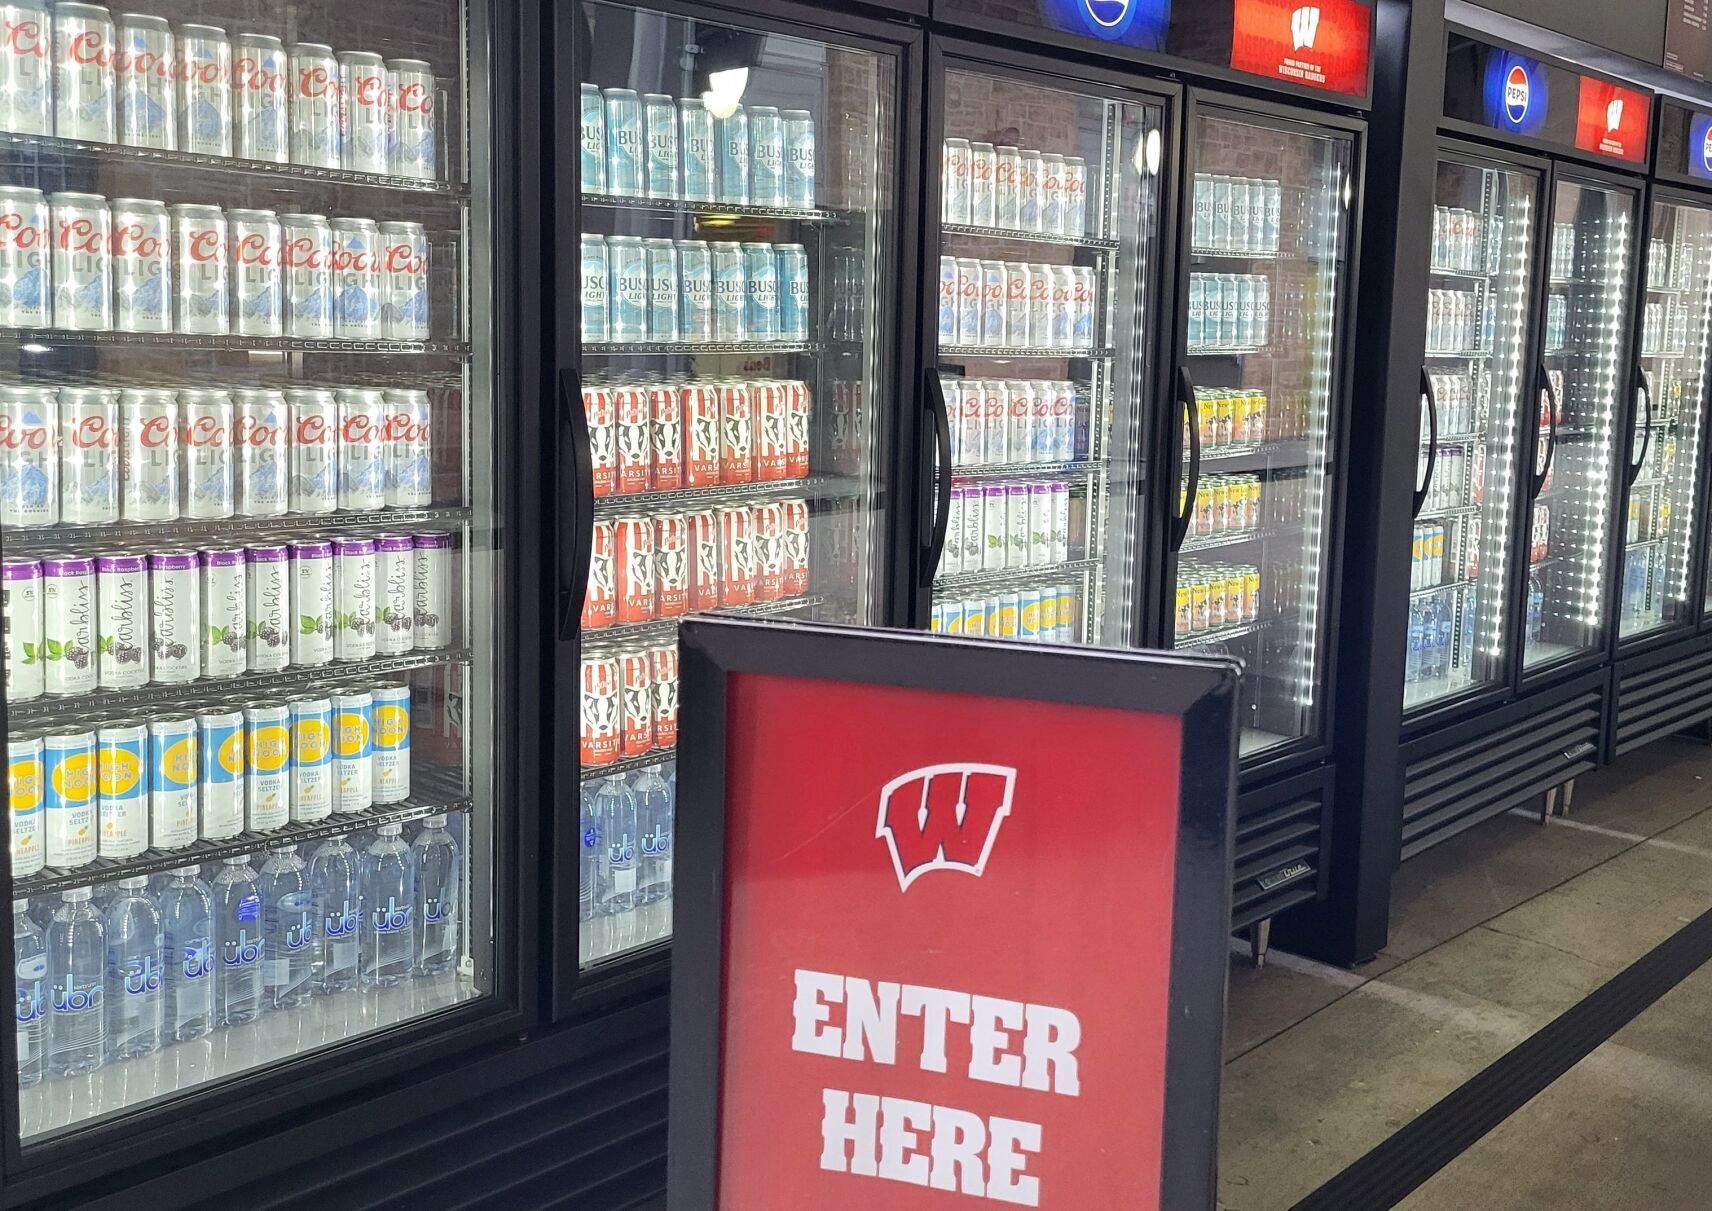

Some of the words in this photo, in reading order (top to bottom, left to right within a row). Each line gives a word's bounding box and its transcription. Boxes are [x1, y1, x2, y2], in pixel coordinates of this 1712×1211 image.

[1507, 86, 1527, 102] PEPSI
[50, 973, 105, 1012] übr
[791, 968, 1081, 1097] ENTER
[820, 1088, 1042, 1207] HERE
